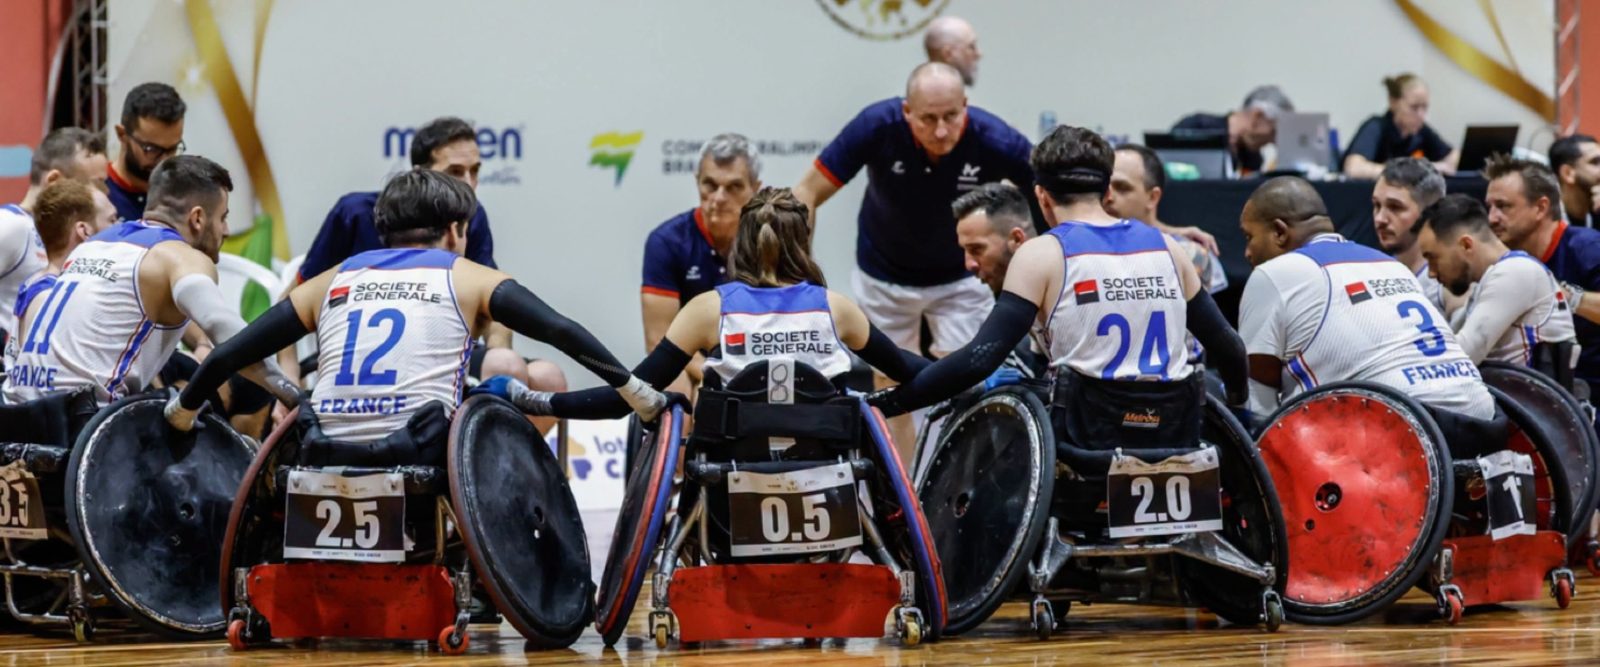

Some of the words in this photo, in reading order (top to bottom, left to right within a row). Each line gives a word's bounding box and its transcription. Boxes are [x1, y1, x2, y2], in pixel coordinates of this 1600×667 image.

[384, 128, 522, 158] men
[662, 140, 701, 156] COM
[355, 282, 428, 293] SOCIETE
[1103, 276, 1165, 289] SOCIETE
[1105, 288, 1177, 301] GENERALE
[353, 291, 442, 303] GENERALE
[22, 281, 79, 354] 11
[1396, 300, 1447, 357] 3
[334, 308, 406, 386] 12
[751, 330, 820, 343] SOCIETE
[751, 342, 832, 355] GENERALE
[1096, 311, 1172, 382] 24
[1401, 361, 1479, 385] FRANCE
[319, 395, 407, 415] FRANCE
[1131, 475, 1192, 523] 2.0
[315, 500, 380, 549] 2.5
[760, 493, 831, 543] 0.5
